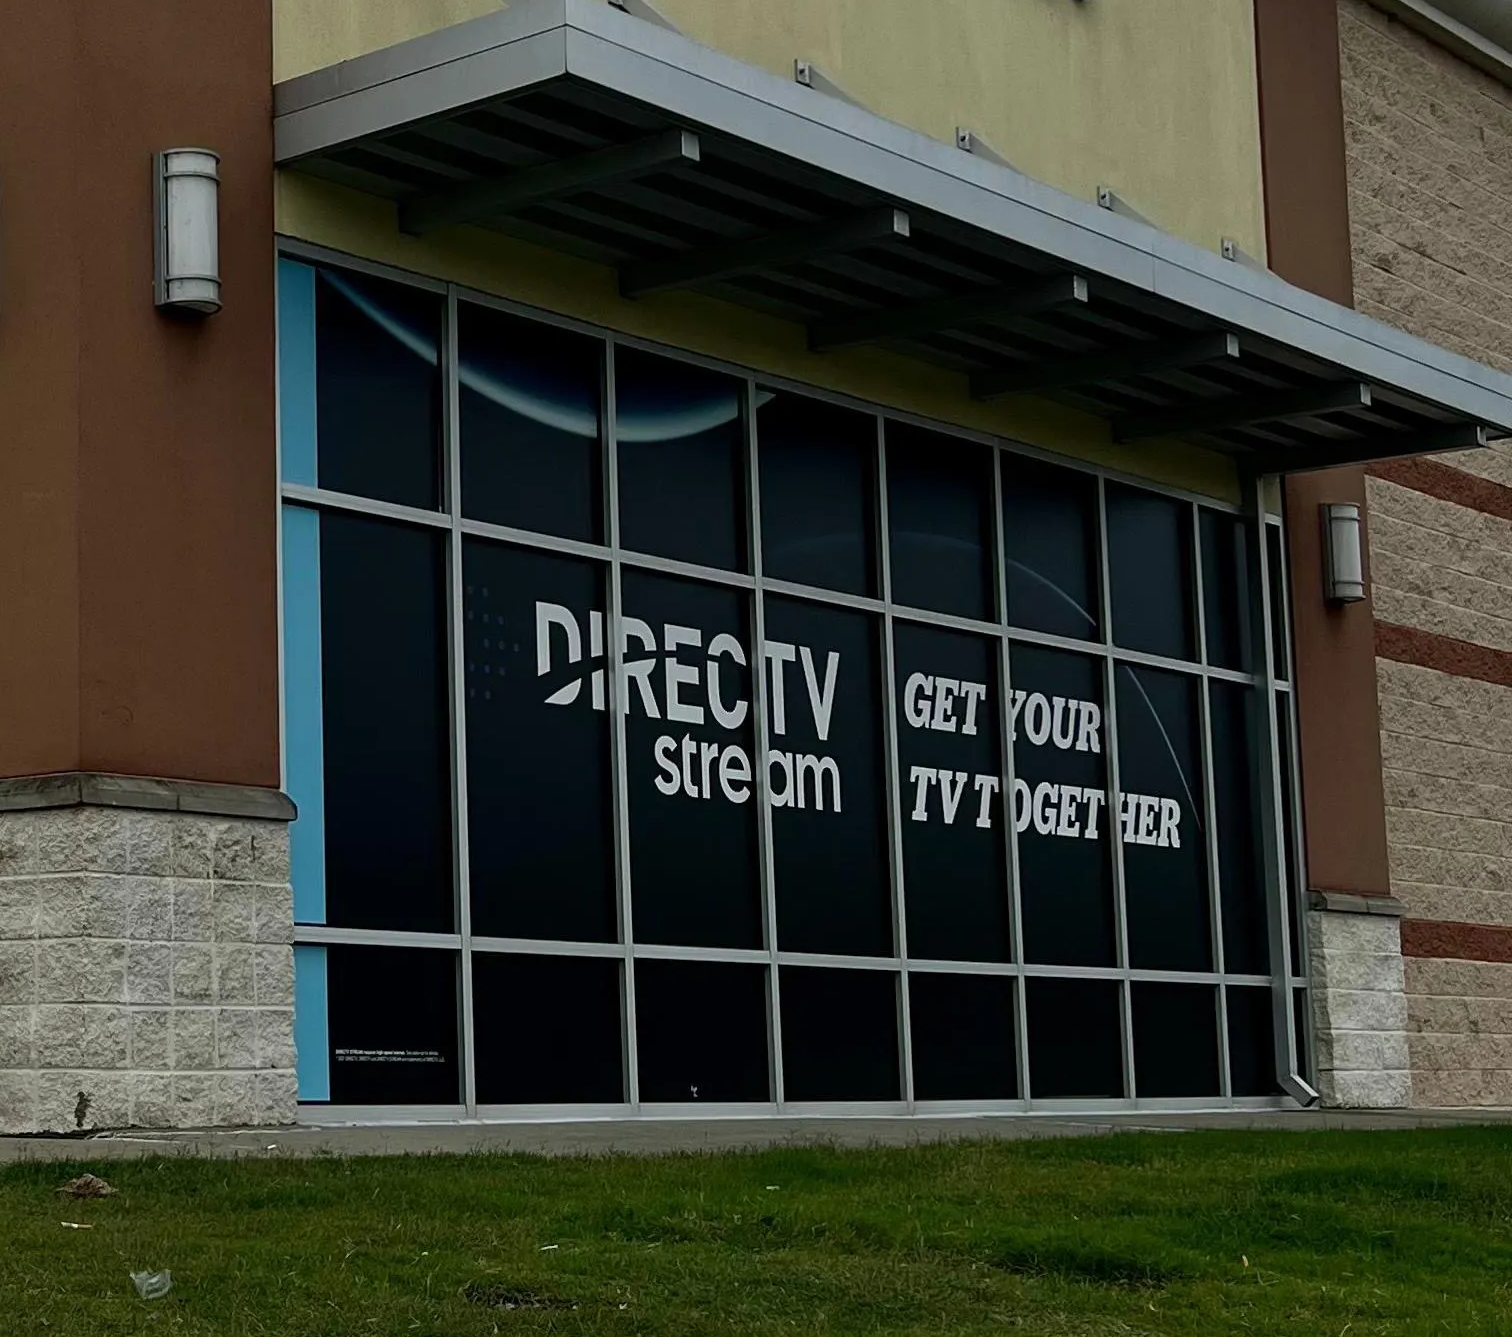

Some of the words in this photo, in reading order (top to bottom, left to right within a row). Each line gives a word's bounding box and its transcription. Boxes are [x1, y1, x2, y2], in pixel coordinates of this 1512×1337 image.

[535, 601, 839, 741] DIRECTV
[904, 672, 987, 736] GET
[1008, 689, 1101, 753] YOUR
[654, 733, 841, 812] stream
[910, 765, 968, 825] TV
[974, 774, 1181, 848] TOGETHER
